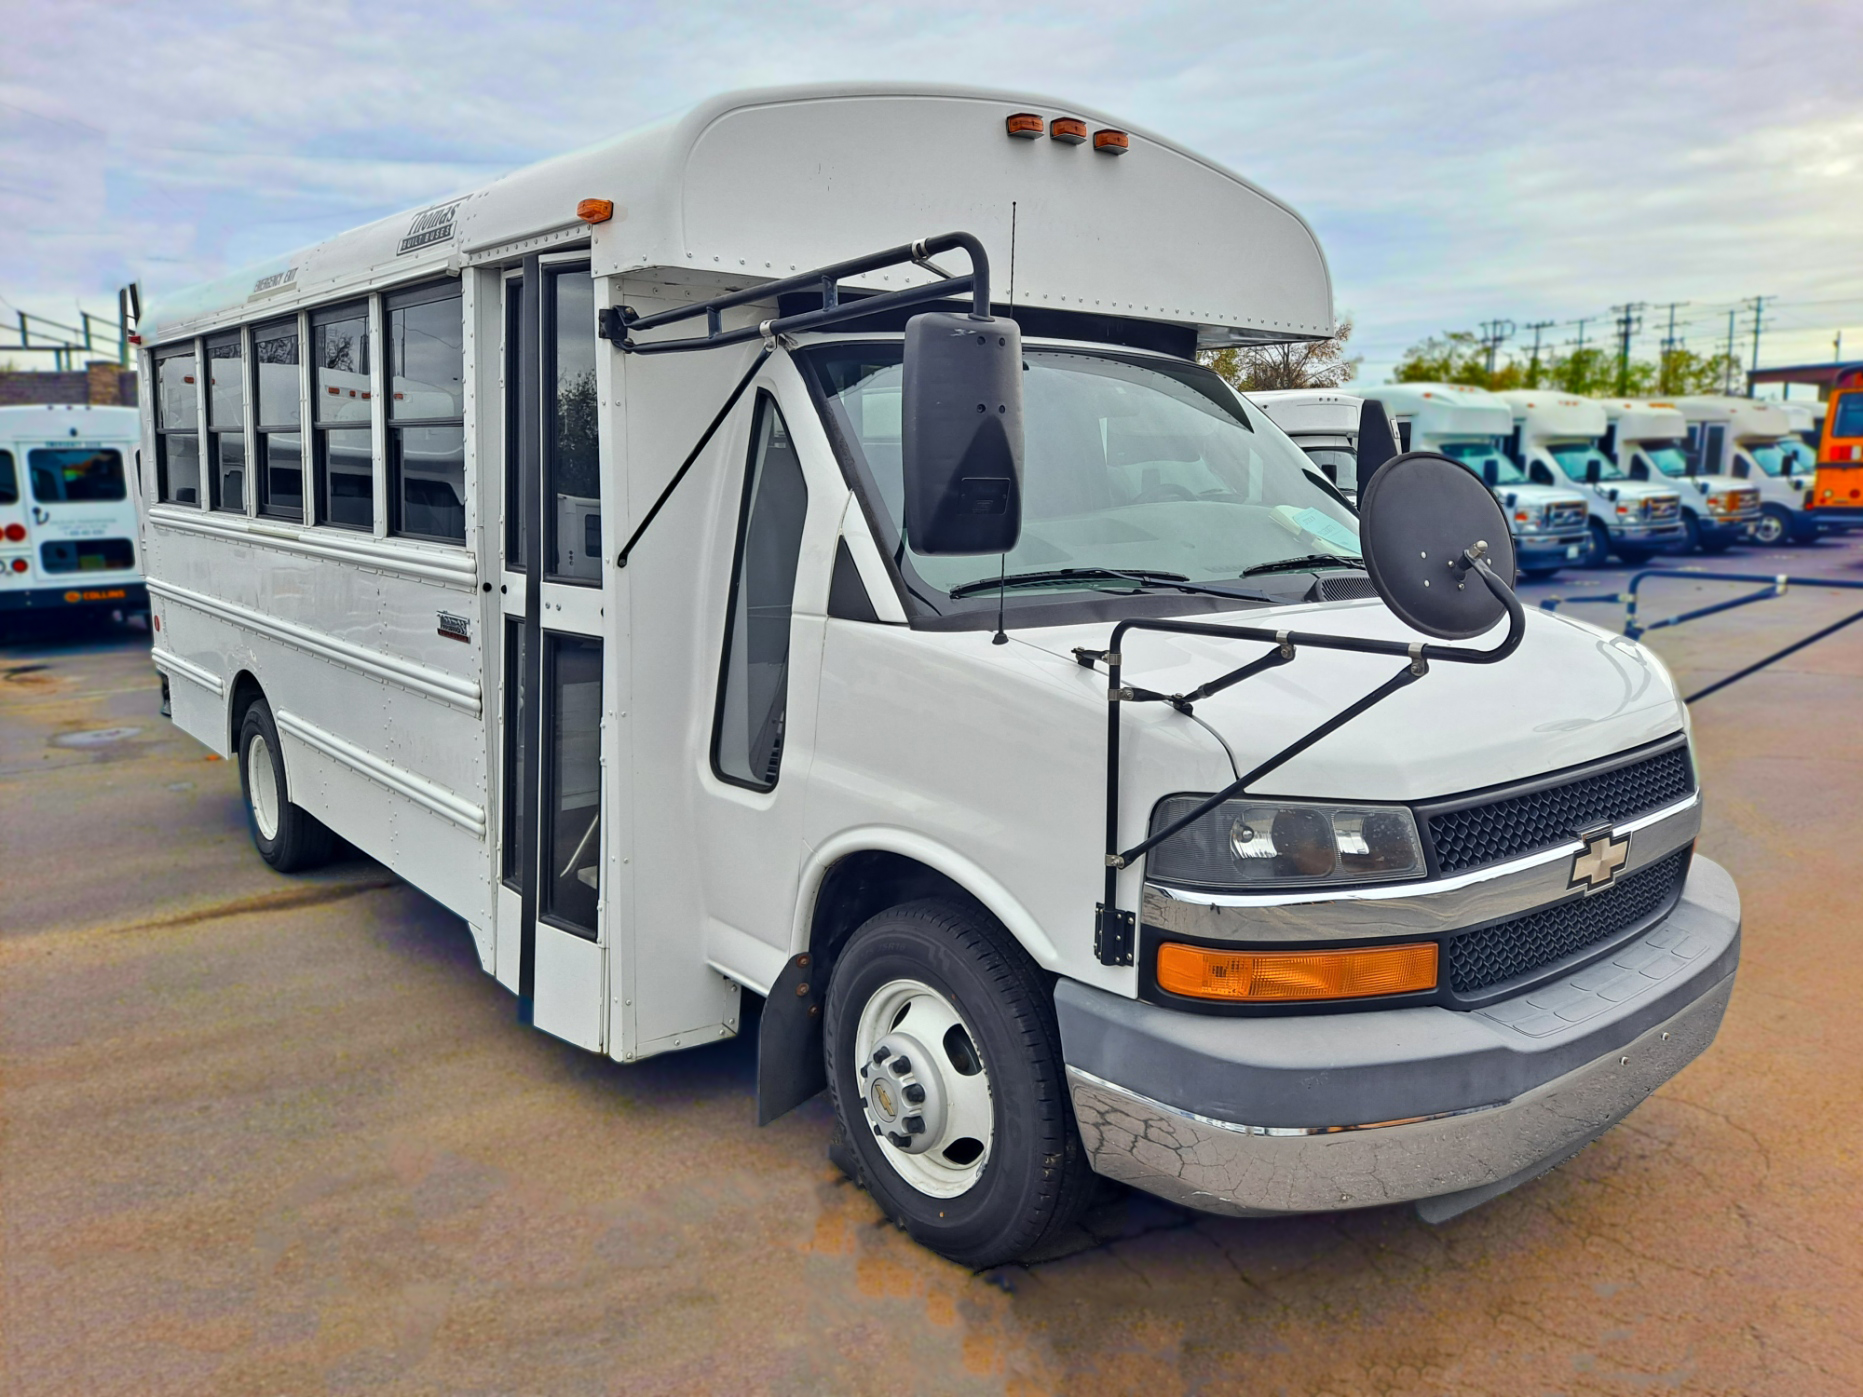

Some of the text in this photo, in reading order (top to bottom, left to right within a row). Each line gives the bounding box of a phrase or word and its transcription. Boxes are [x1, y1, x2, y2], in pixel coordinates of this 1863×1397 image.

[402, 226, 450, 250] BUILT BUSES
[254, 267, 299, 292] EMERGENCY EXIT
[82, 589, 126, 601] COLLINS
